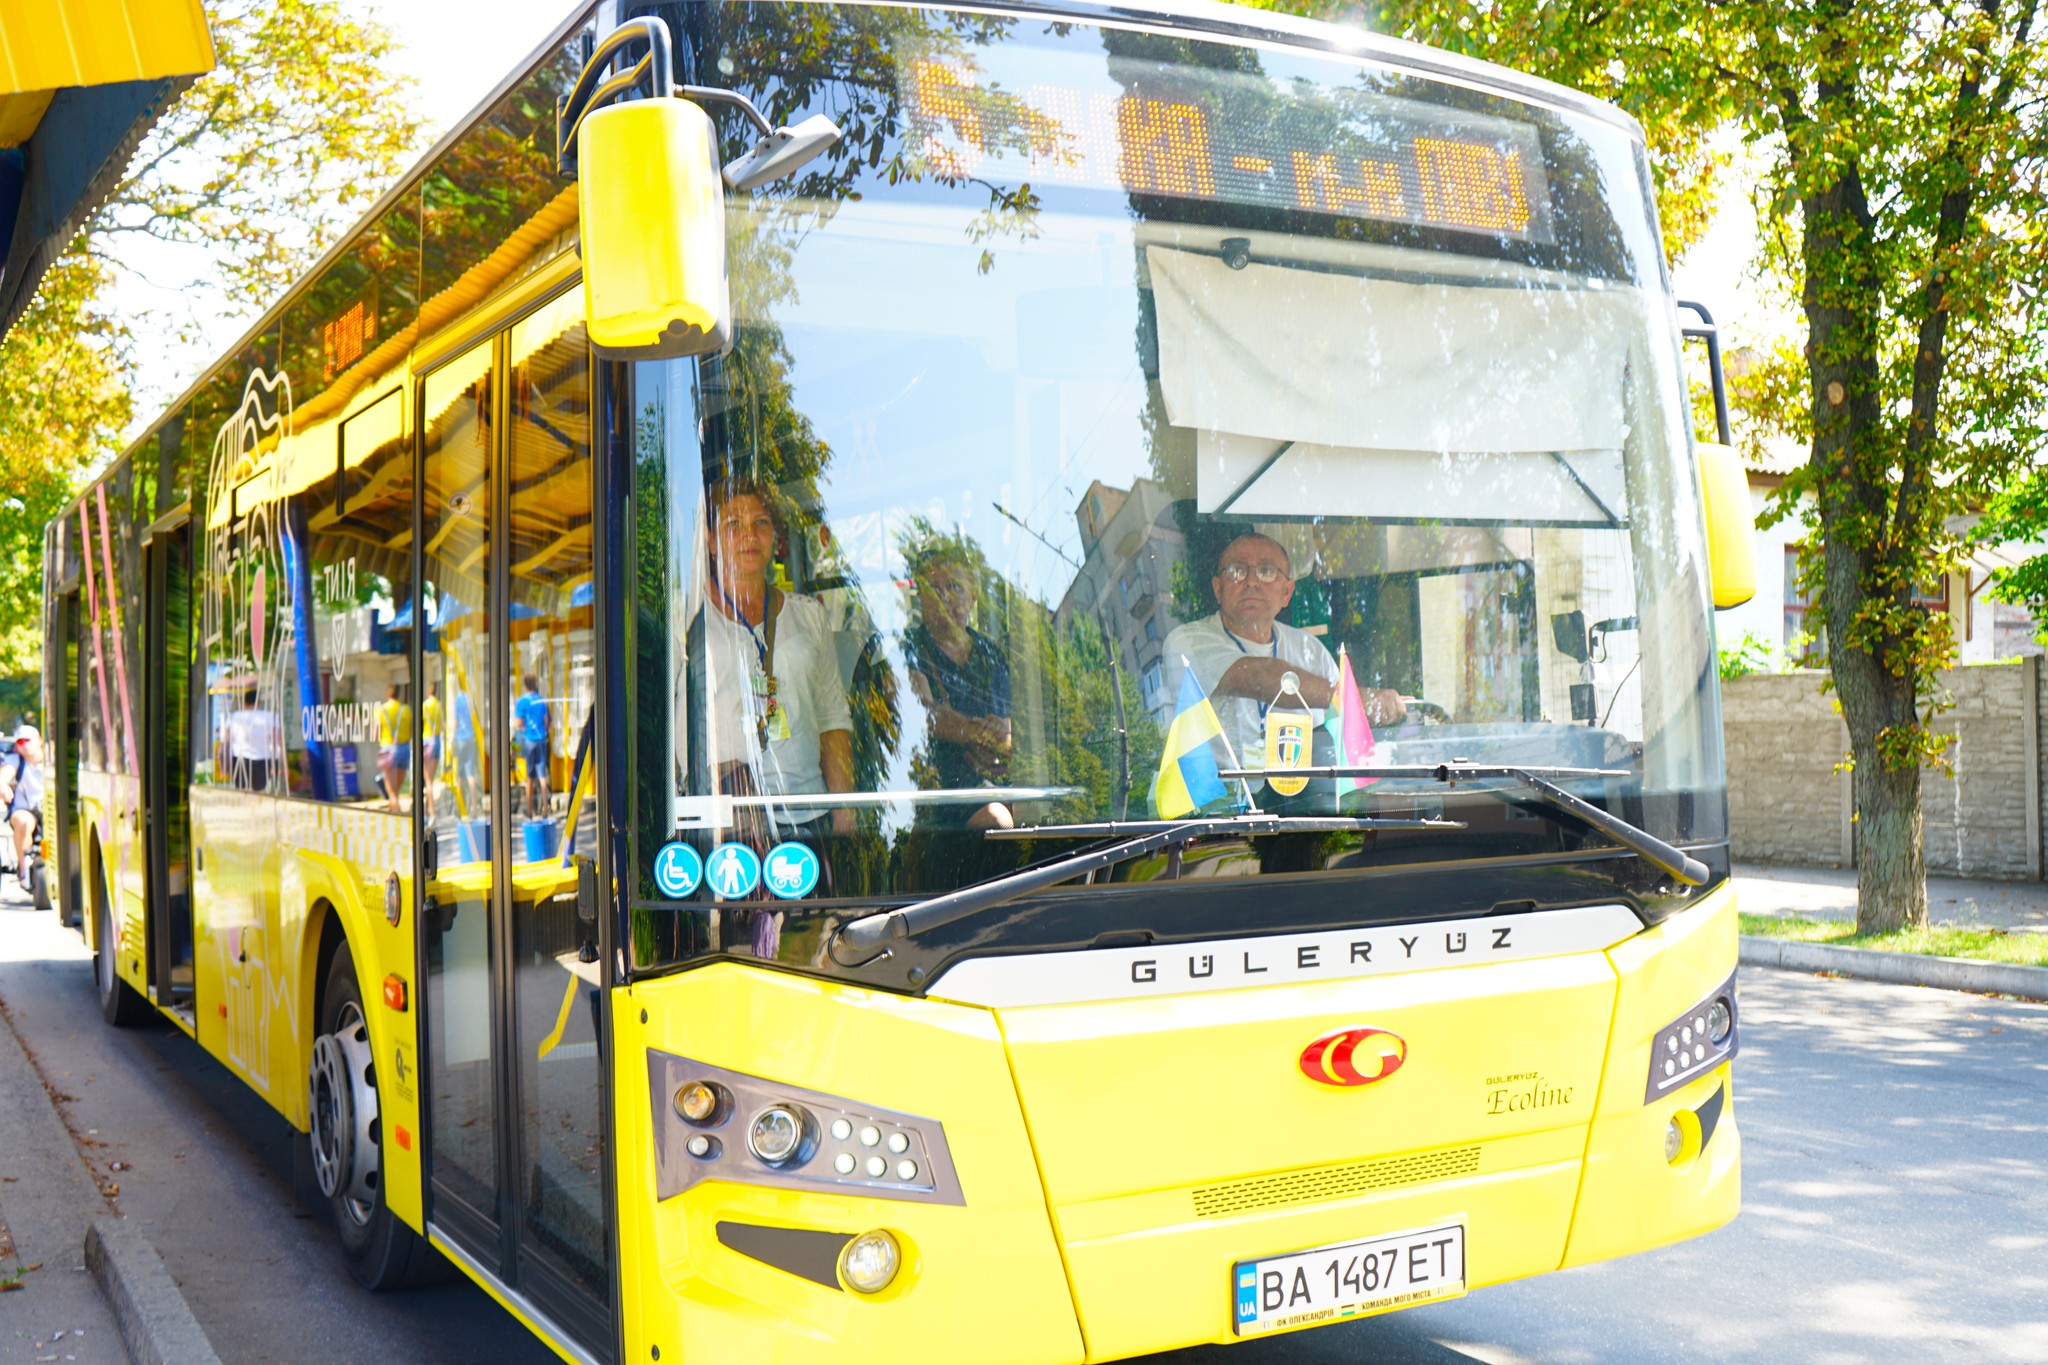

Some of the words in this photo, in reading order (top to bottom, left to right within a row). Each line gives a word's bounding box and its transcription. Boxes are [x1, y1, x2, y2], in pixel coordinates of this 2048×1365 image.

[301, 700, 382, 743] ОЛЕКСАНДРІЯ
[1131, 926, 1513, 984] GÜLERYÜZ
[1486, 1076, 1573, 1115] Ecoline
[1262, 1266, 1312, 1312] BA
[1325, 1248, 1398, 1299] 1487
[1408, 1238, 1453, 1284] ET
[1240, 1300, 1256, 1317] UA
[1276, 1319, 1287, 1327] ФК
[1289, 1309, 1335, 1325] ОЛЕКСАНДРІЯ
[1362, 1297, 1393, 1311] КОМАНДА
[1394, 1294, 1411, 1304] МОГО
[1413, 1290, 1431, 1301] МІСТА
